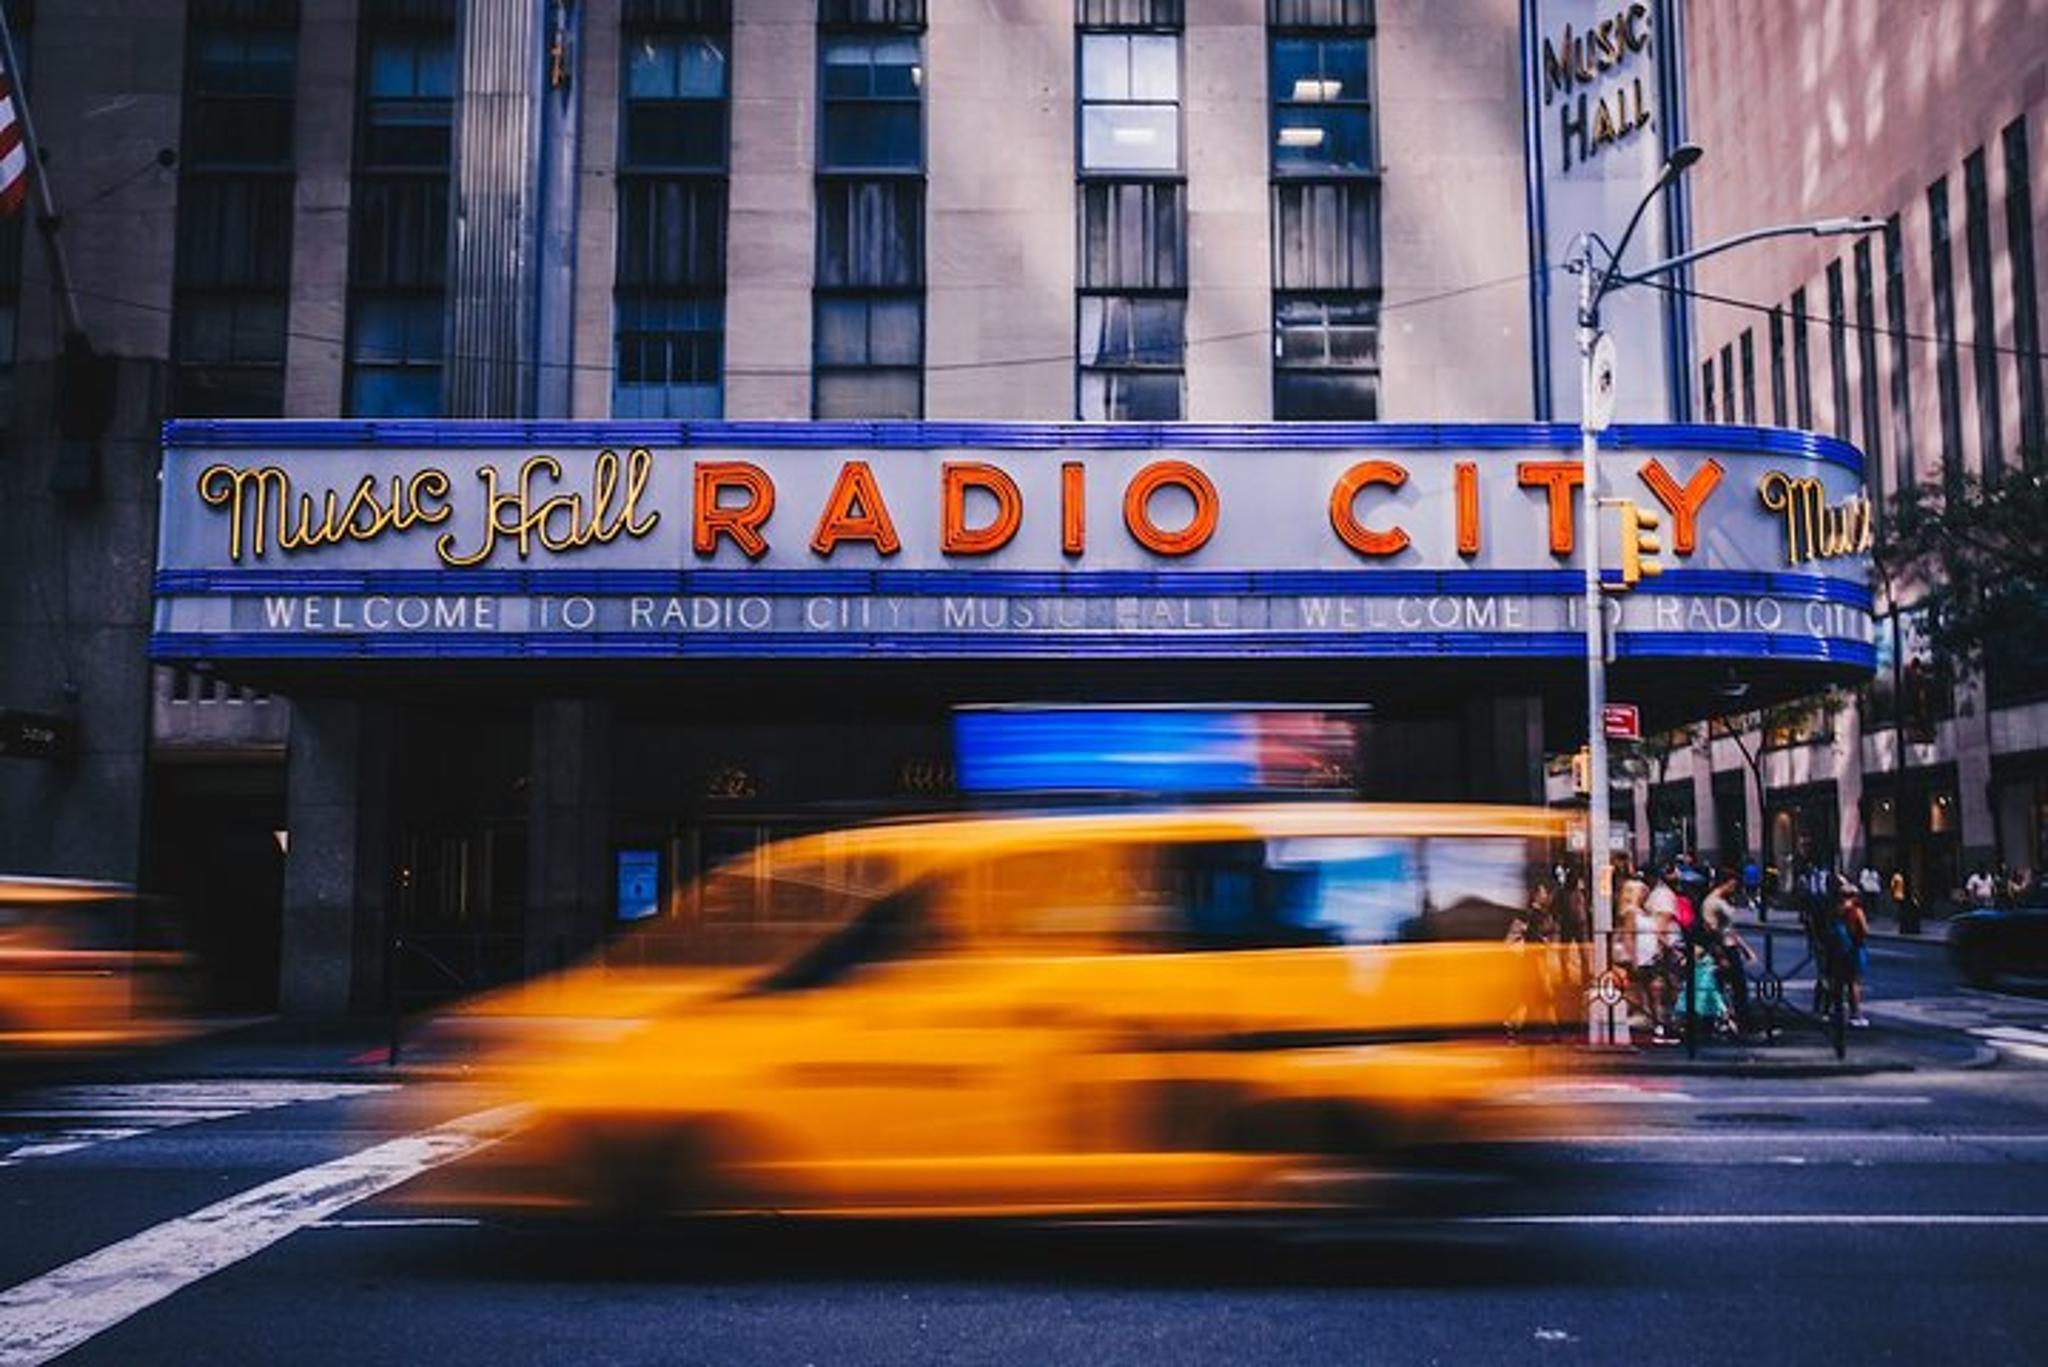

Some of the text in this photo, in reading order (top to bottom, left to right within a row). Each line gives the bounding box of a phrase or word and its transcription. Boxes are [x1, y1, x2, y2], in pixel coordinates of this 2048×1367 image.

[1543, 4, 1648, 106] MUSIC
[1561, 77, 1650, 172] HALL
[198, 448, 660, 567] Music Hall
[693, 457, 1726, 557] RADIO CITY
[264, 597, 494, 629] WELCOME
[532, 596, 597, 630] TO
[630, 597, 771, 630] RADIO
[807, 596, 905, 630] CITY
[943, 596, 1085, 629] MUSIC
[1301, 596, 1523, 629] WELCOME
[1656, 597, 1782, 631] RADIO
